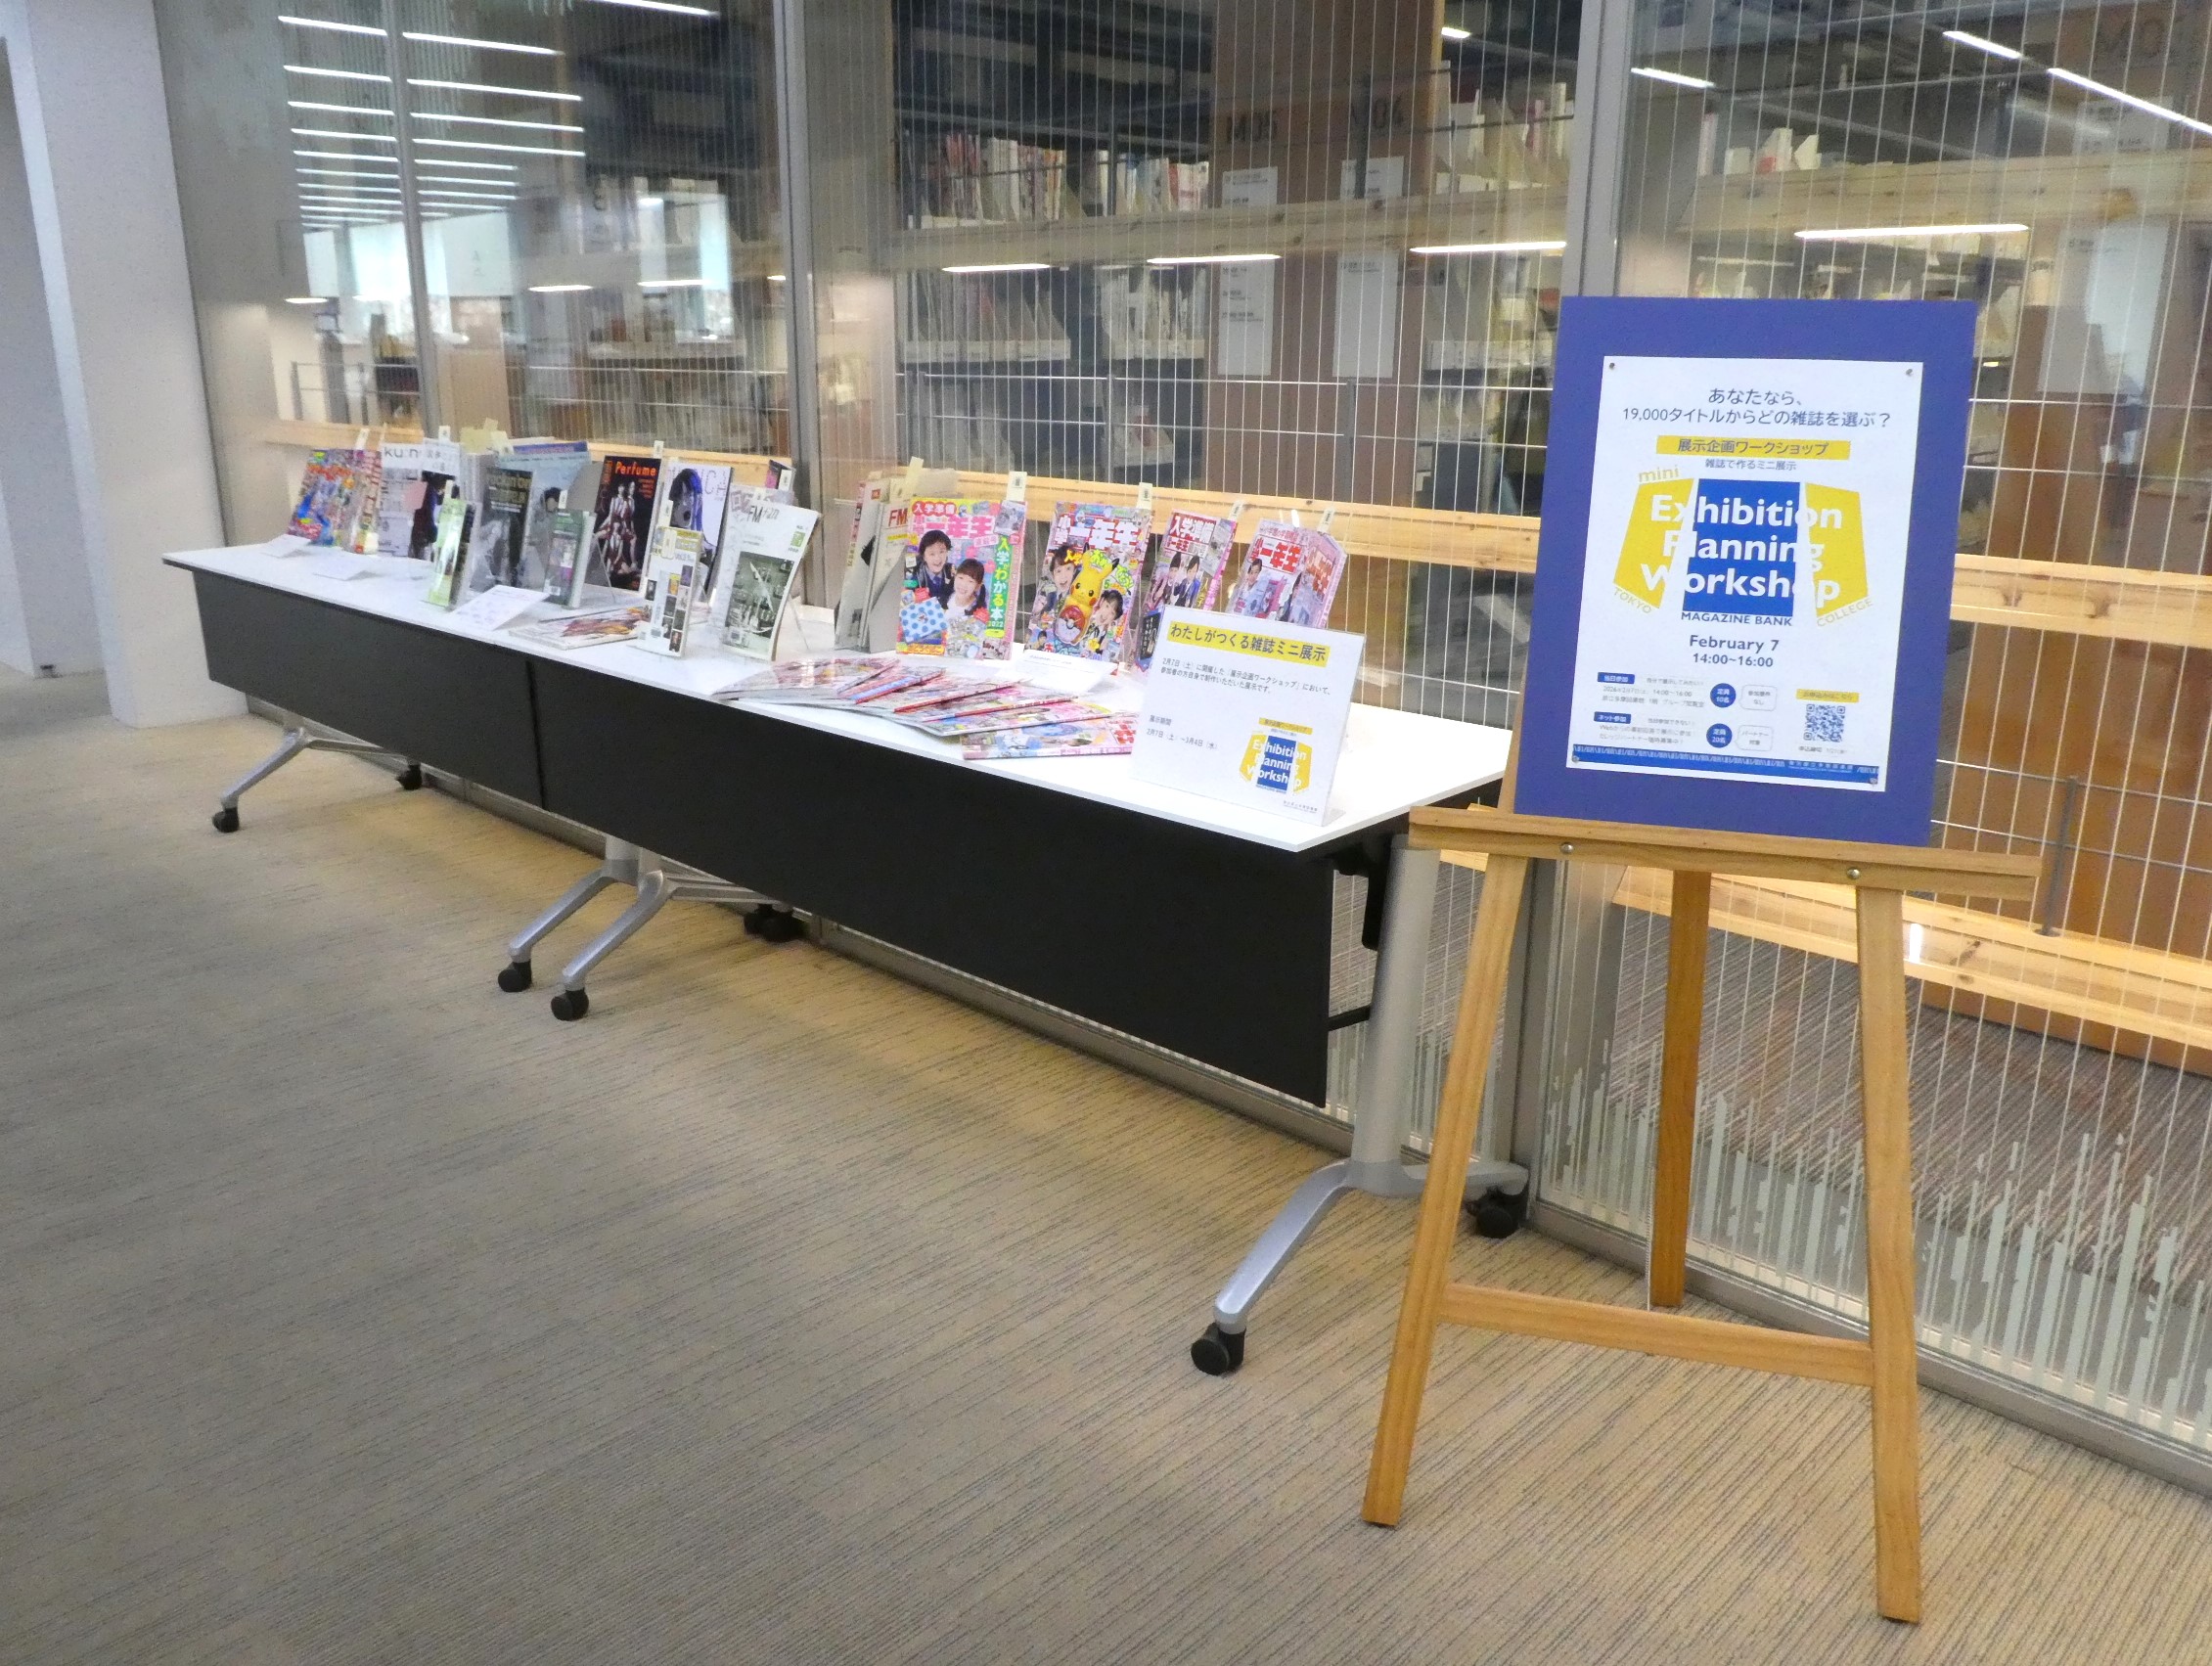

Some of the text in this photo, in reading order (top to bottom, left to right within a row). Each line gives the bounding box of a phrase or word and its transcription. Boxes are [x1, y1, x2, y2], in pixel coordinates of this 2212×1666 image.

[1709, 388, 1802, 406] あなたなら、
[1623, 408, 1890, 428] 19,000タイトルからどの雑誌を選ぶ？
[1678, 438, 1829, 456] 展示企画ワークショップ
[614, 461, 657, 476] Perfume
[1639, 465, 1680, 482] mini
[1705, 459, 1796, 471] 雑誌で作るミニ展示
[1650, 494, 1842, 529] Exhibition
[1613, 589, 1652, 614] TOKYO
[1681, 611, 1792, 627] MAGAZINE BANK
[1817, 598, 1873, 626] COLLEGE
[1170, 624, 1326, 661] わたしがつくる雑誌ミニ展示
[1689, 634, 1780, 653] February 7
[1246, 764, 1302, 790] Workshp
